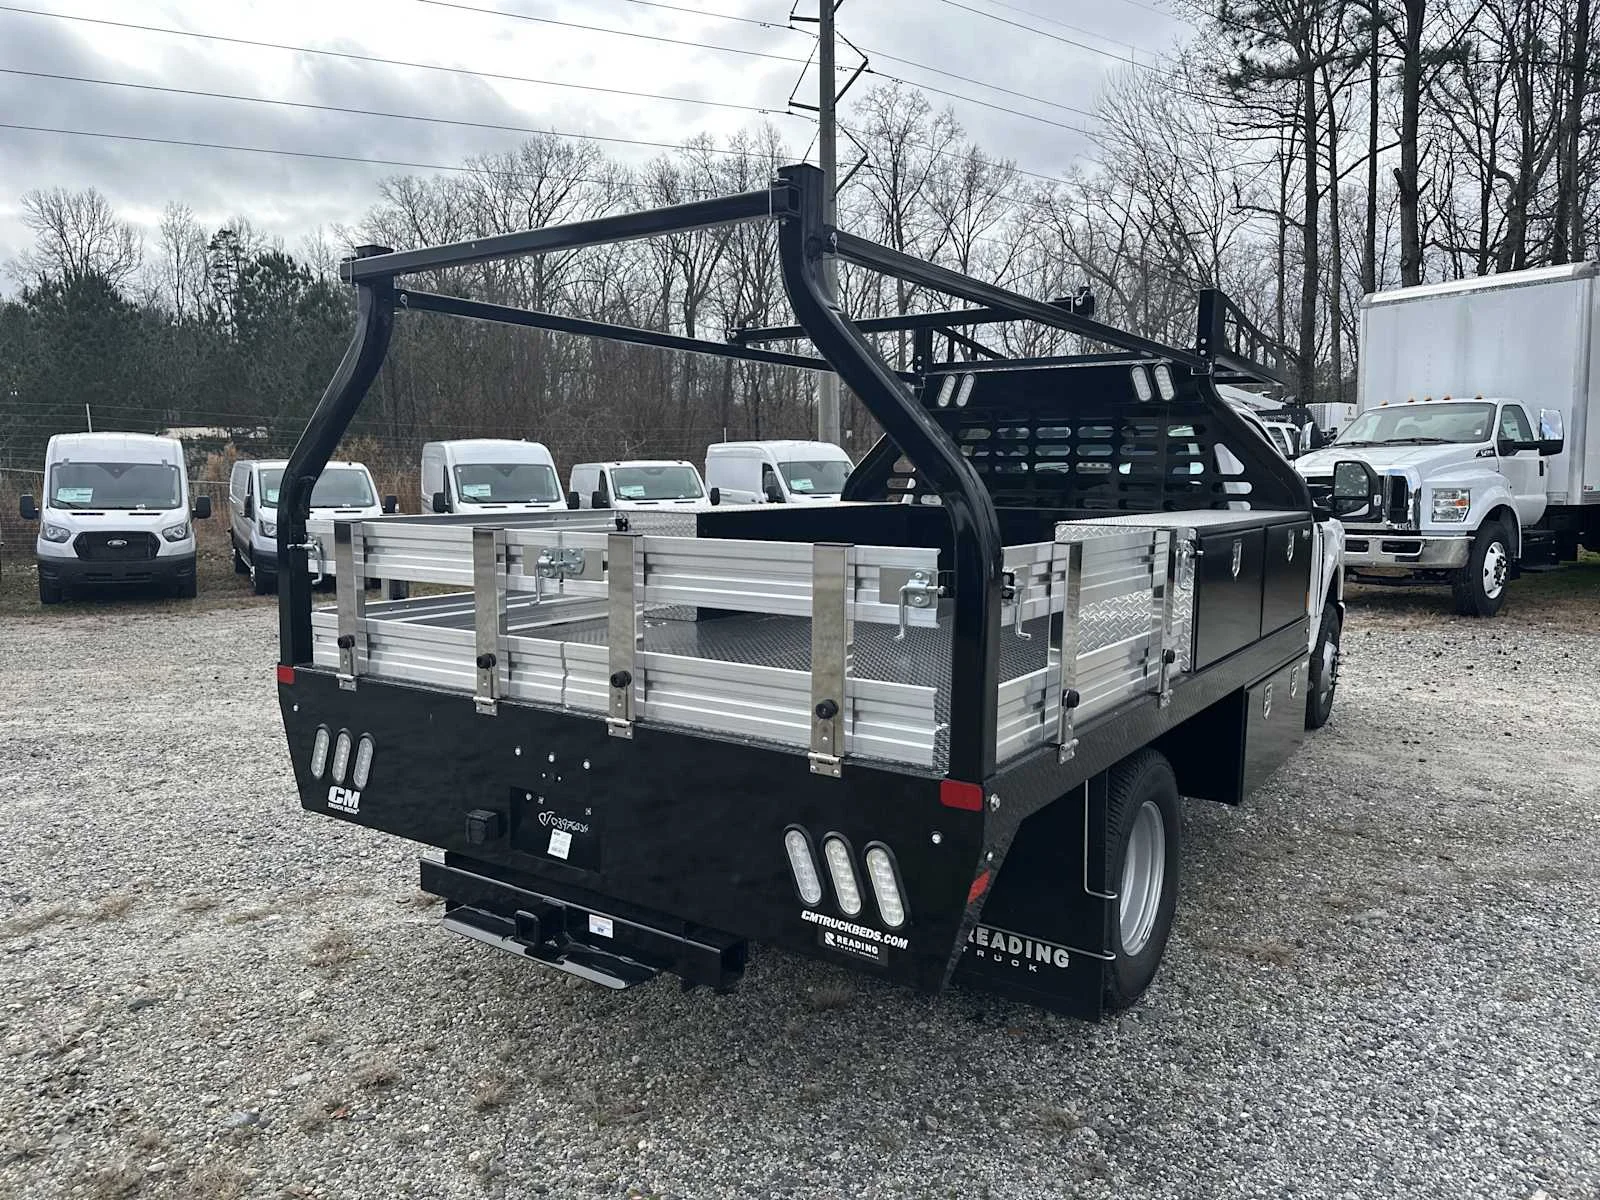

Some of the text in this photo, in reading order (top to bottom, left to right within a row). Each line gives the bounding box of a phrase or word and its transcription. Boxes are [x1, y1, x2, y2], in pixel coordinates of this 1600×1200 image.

[328, 785, 360, 809] CM
[801, 909, 909, 950] CMTRUCKBEDS.COM
[836, 934, 880, 955] READING
